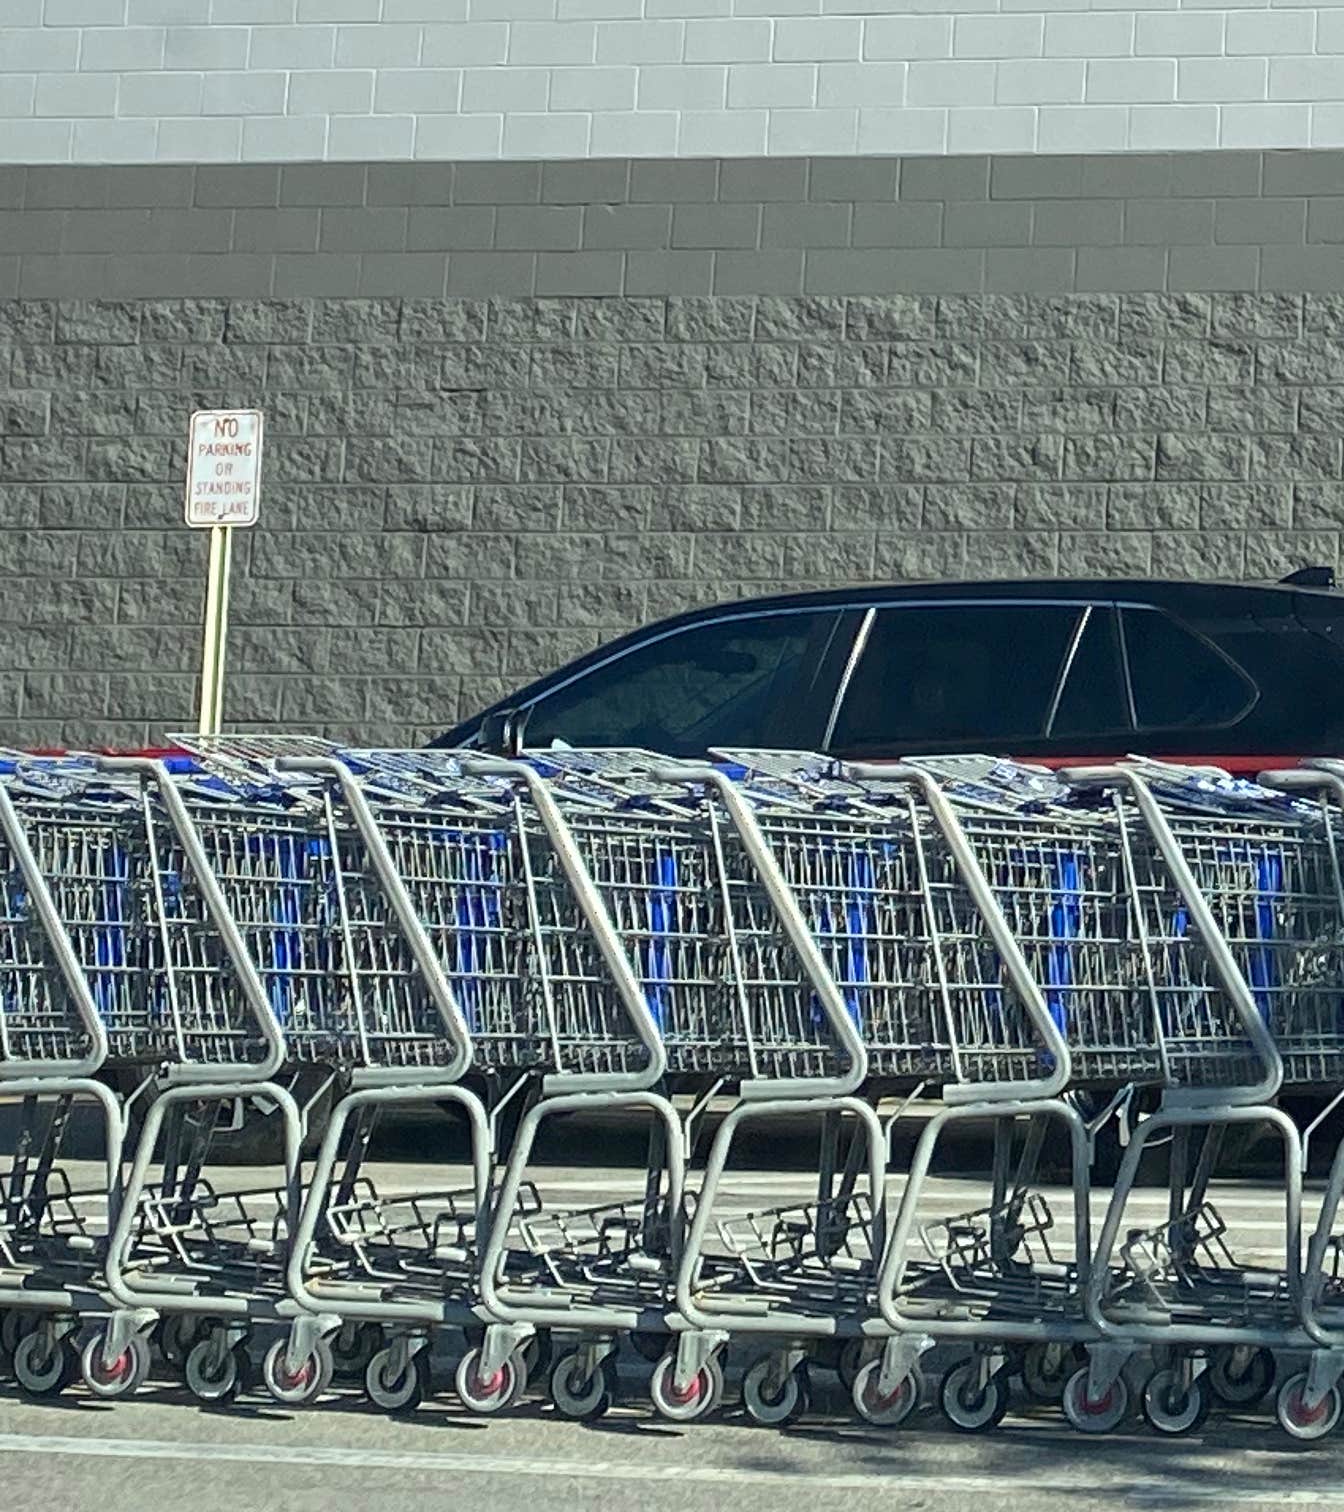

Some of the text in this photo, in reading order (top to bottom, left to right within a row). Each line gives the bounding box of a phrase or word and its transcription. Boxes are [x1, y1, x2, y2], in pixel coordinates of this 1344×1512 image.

[214, 418, 239, 438] NO
[198, 442, 252, 457] PARKING
[215, 462, 233, 476] OR
[194, 481, 251, 496] STANDING
[194, 501, 249, 516] FIRE LANE
